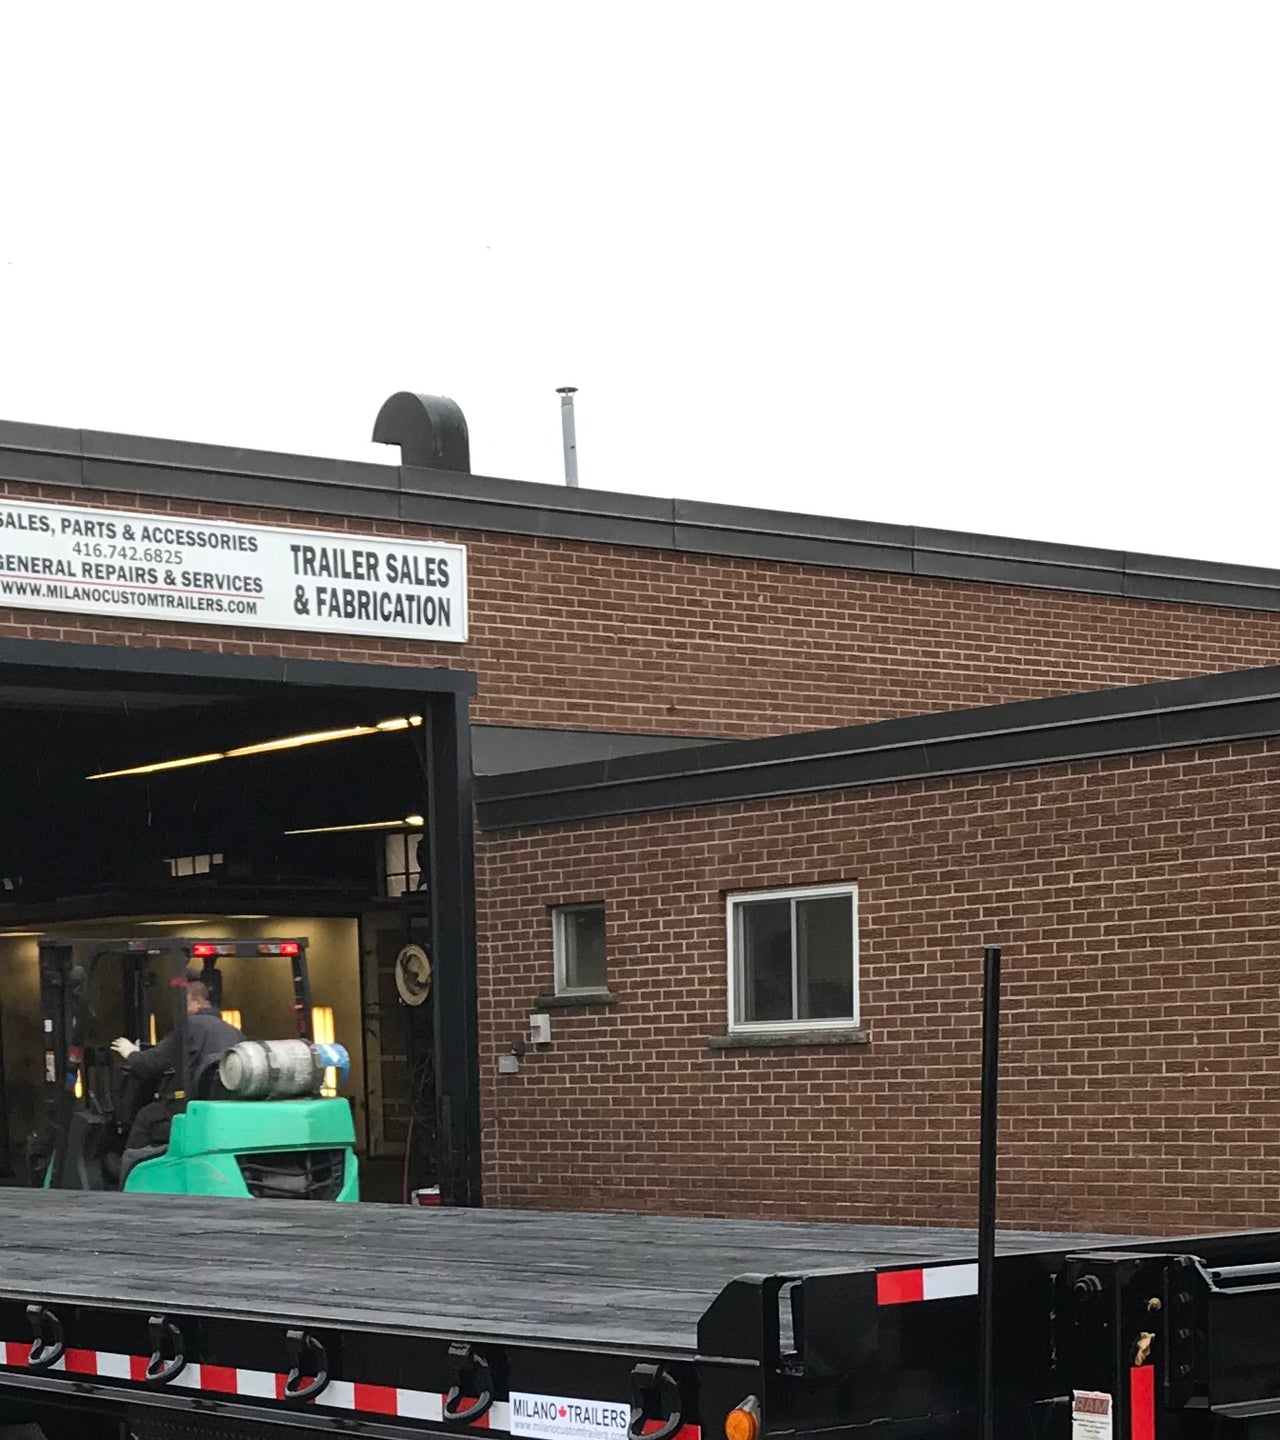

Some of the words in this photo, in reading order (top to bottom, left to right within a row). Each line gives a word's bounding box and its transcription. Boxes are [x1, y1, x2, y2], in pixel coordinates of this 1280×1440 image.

[61, 518, 117, 540] PARTS
[122, 524, 136, 541] &
[141, 526, 258, 552] ACCESSORIES
[72, 541, 183, 565] 416.742.6825
[290, 544, 380, 582] TRAILER
[386, 553, 450, 588] SALES
[82, 562, 158, 584] REPAIRS
[163, 569, 176, 586] &
[181, 571, 264, 593] SERVICES
[0, 580, 258, 615] WWW.MILANOCUSTOMTRAILERS.COM
[294, 584, 310, 616] &
[316, 586, 451, 627] FABRICATION
[513, 1398, 558, 1421] MILANO
[567, 1405, 627, 1428] TRAILERS
